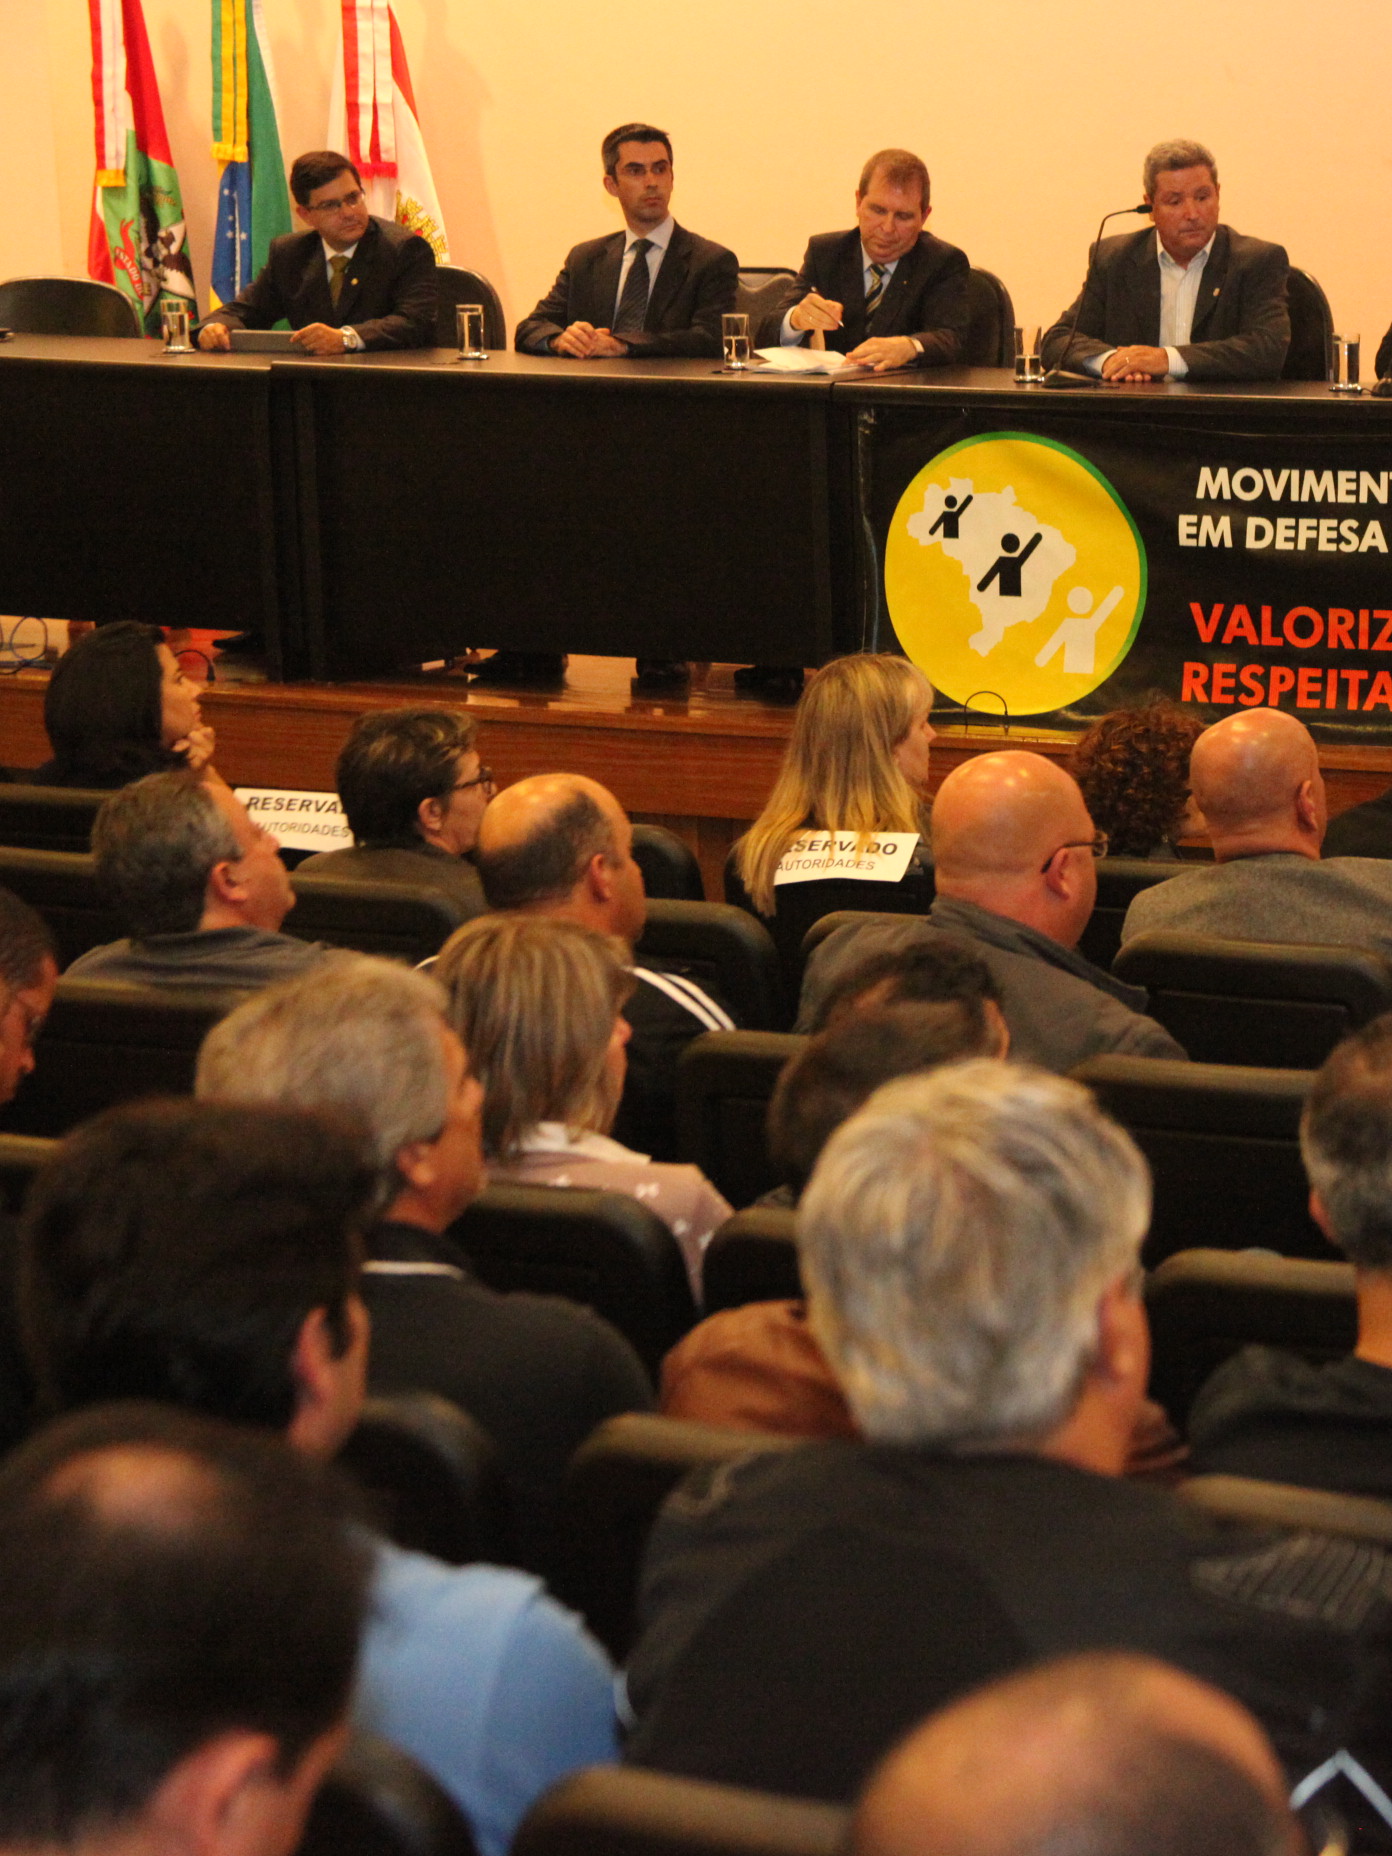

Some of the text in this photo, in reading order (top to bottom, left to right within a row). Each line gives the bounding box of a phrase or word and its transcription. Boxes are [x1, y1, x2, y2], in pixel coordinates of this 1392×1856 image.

[1178, 514, 1233, 548] EM
[1245, 516, 1389, 553] DEFESA
[247, 796, 338, 814] RESERVA
